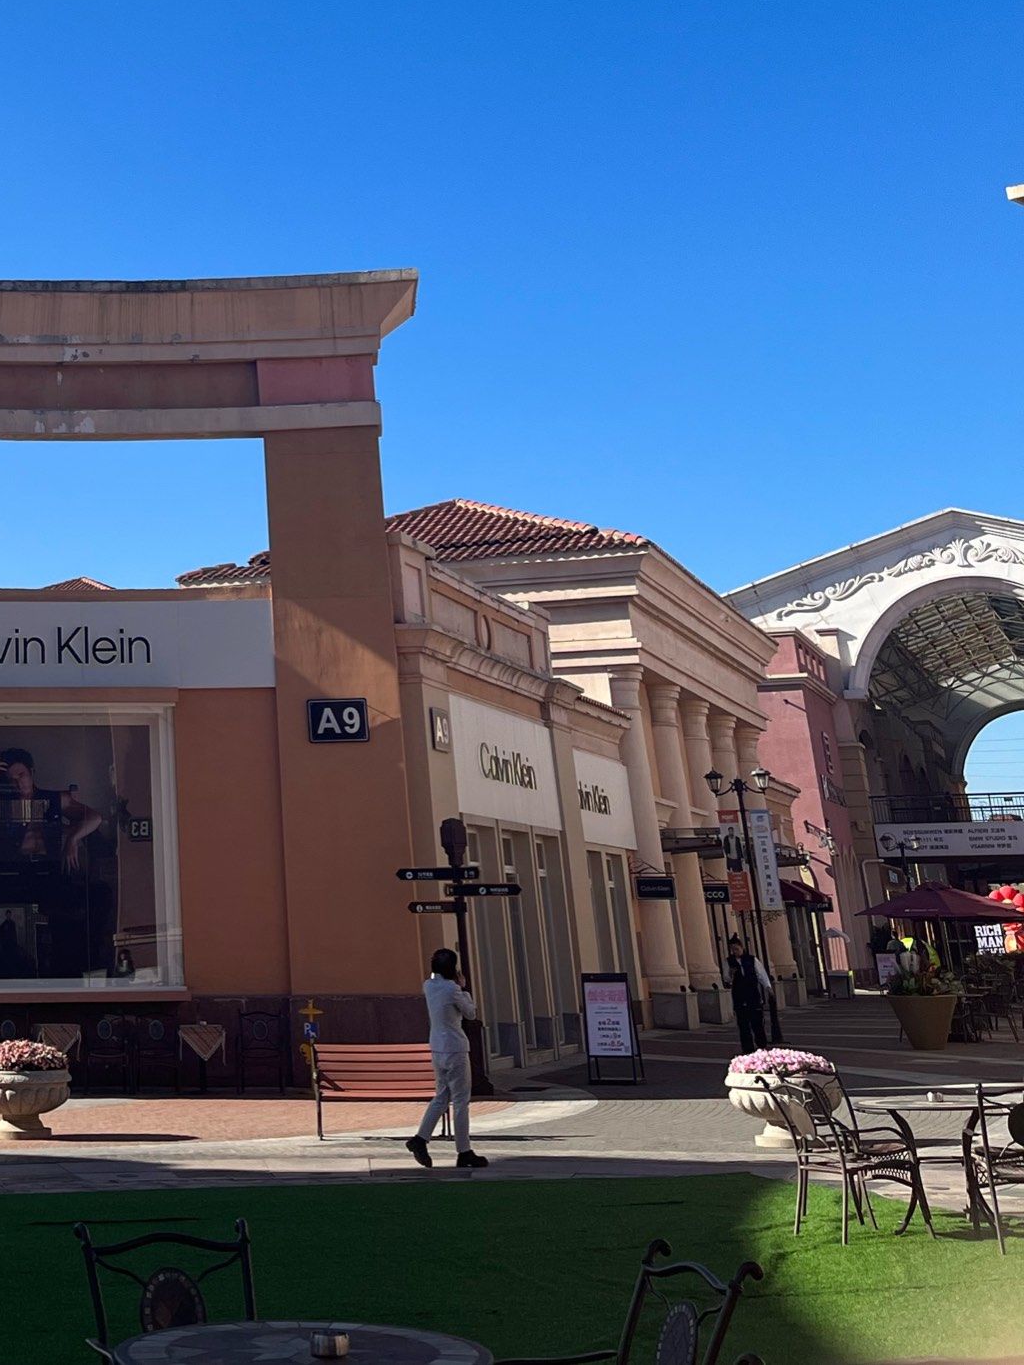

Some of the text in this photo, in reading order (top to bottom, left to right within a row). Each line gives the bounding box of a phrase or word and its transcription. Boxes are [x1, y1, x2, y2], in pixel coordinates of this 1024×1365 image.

[57, 626, 152, 665] Klein
[317, 706, 361, 734] A9
[436, 716, 450, 744] A9
[480, 742, 538, 790] Calvin Klein
[591, 784, 611, 816] Klein
[974, 923, 1002, 937] RICH
[976, 936, 1004, 949] MAN
